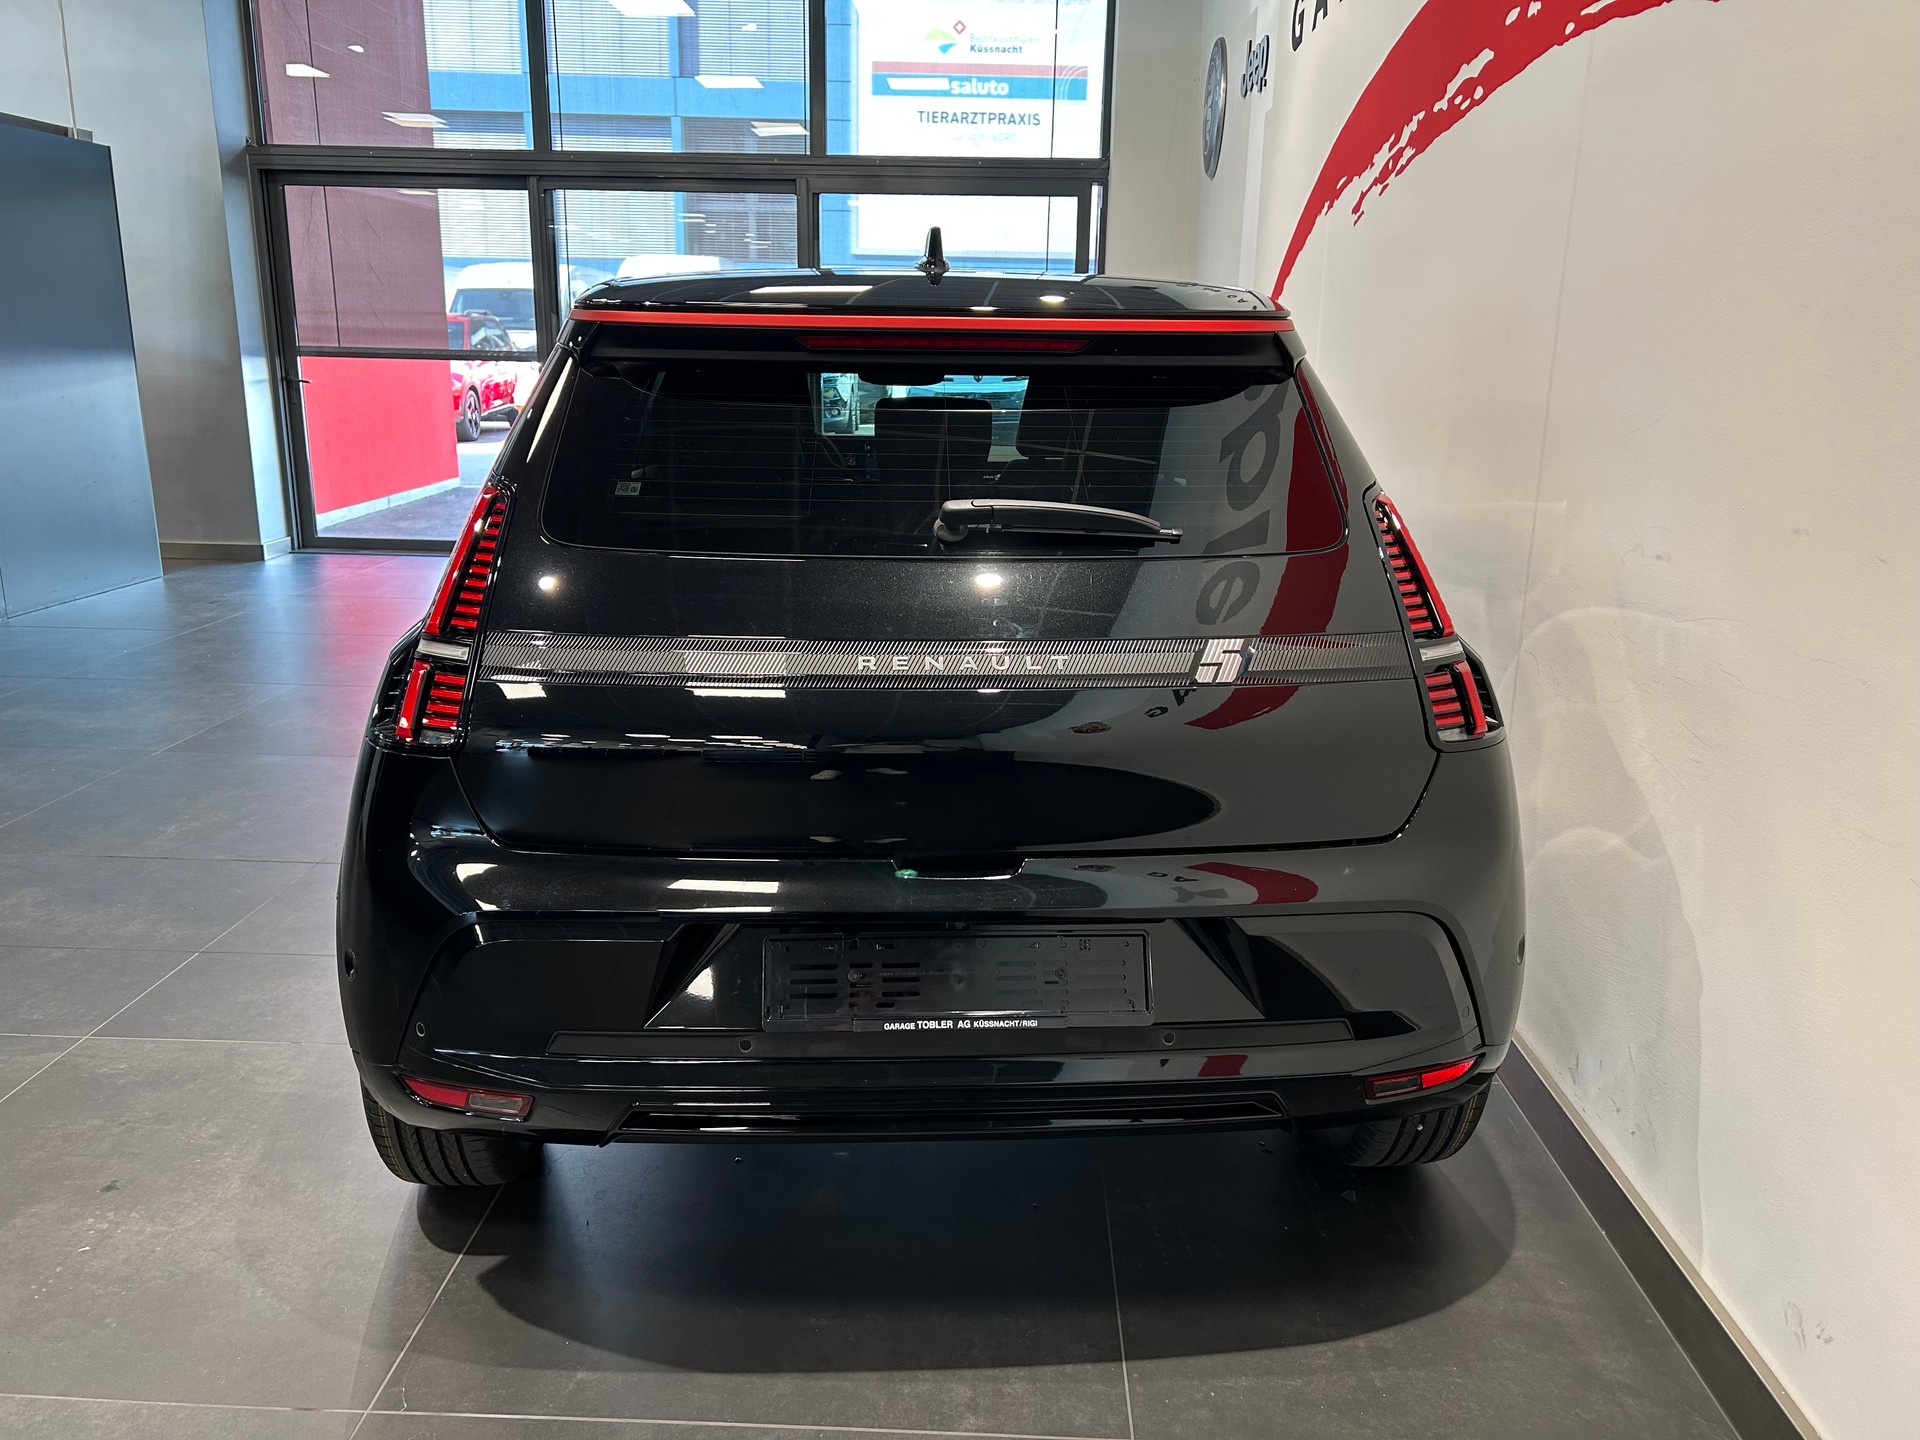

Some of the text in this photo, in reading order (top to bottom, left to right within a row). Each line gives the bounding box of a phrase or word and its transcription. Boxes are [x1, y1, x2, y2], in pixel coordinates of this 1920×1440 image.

[1291, 0, 1344, 52] GA
[970, 43, 1023, 54] Küssnacht
[950, 77, 1009, 96] saluto
[917, 110, 1041, 126] TIERARZTPRAXIS
[857, 655, 1070, 671] RENAULT
[883, 1019, 1038, 1030] GARAGE TOBLER AG KÜSSNACHT/RIGI
